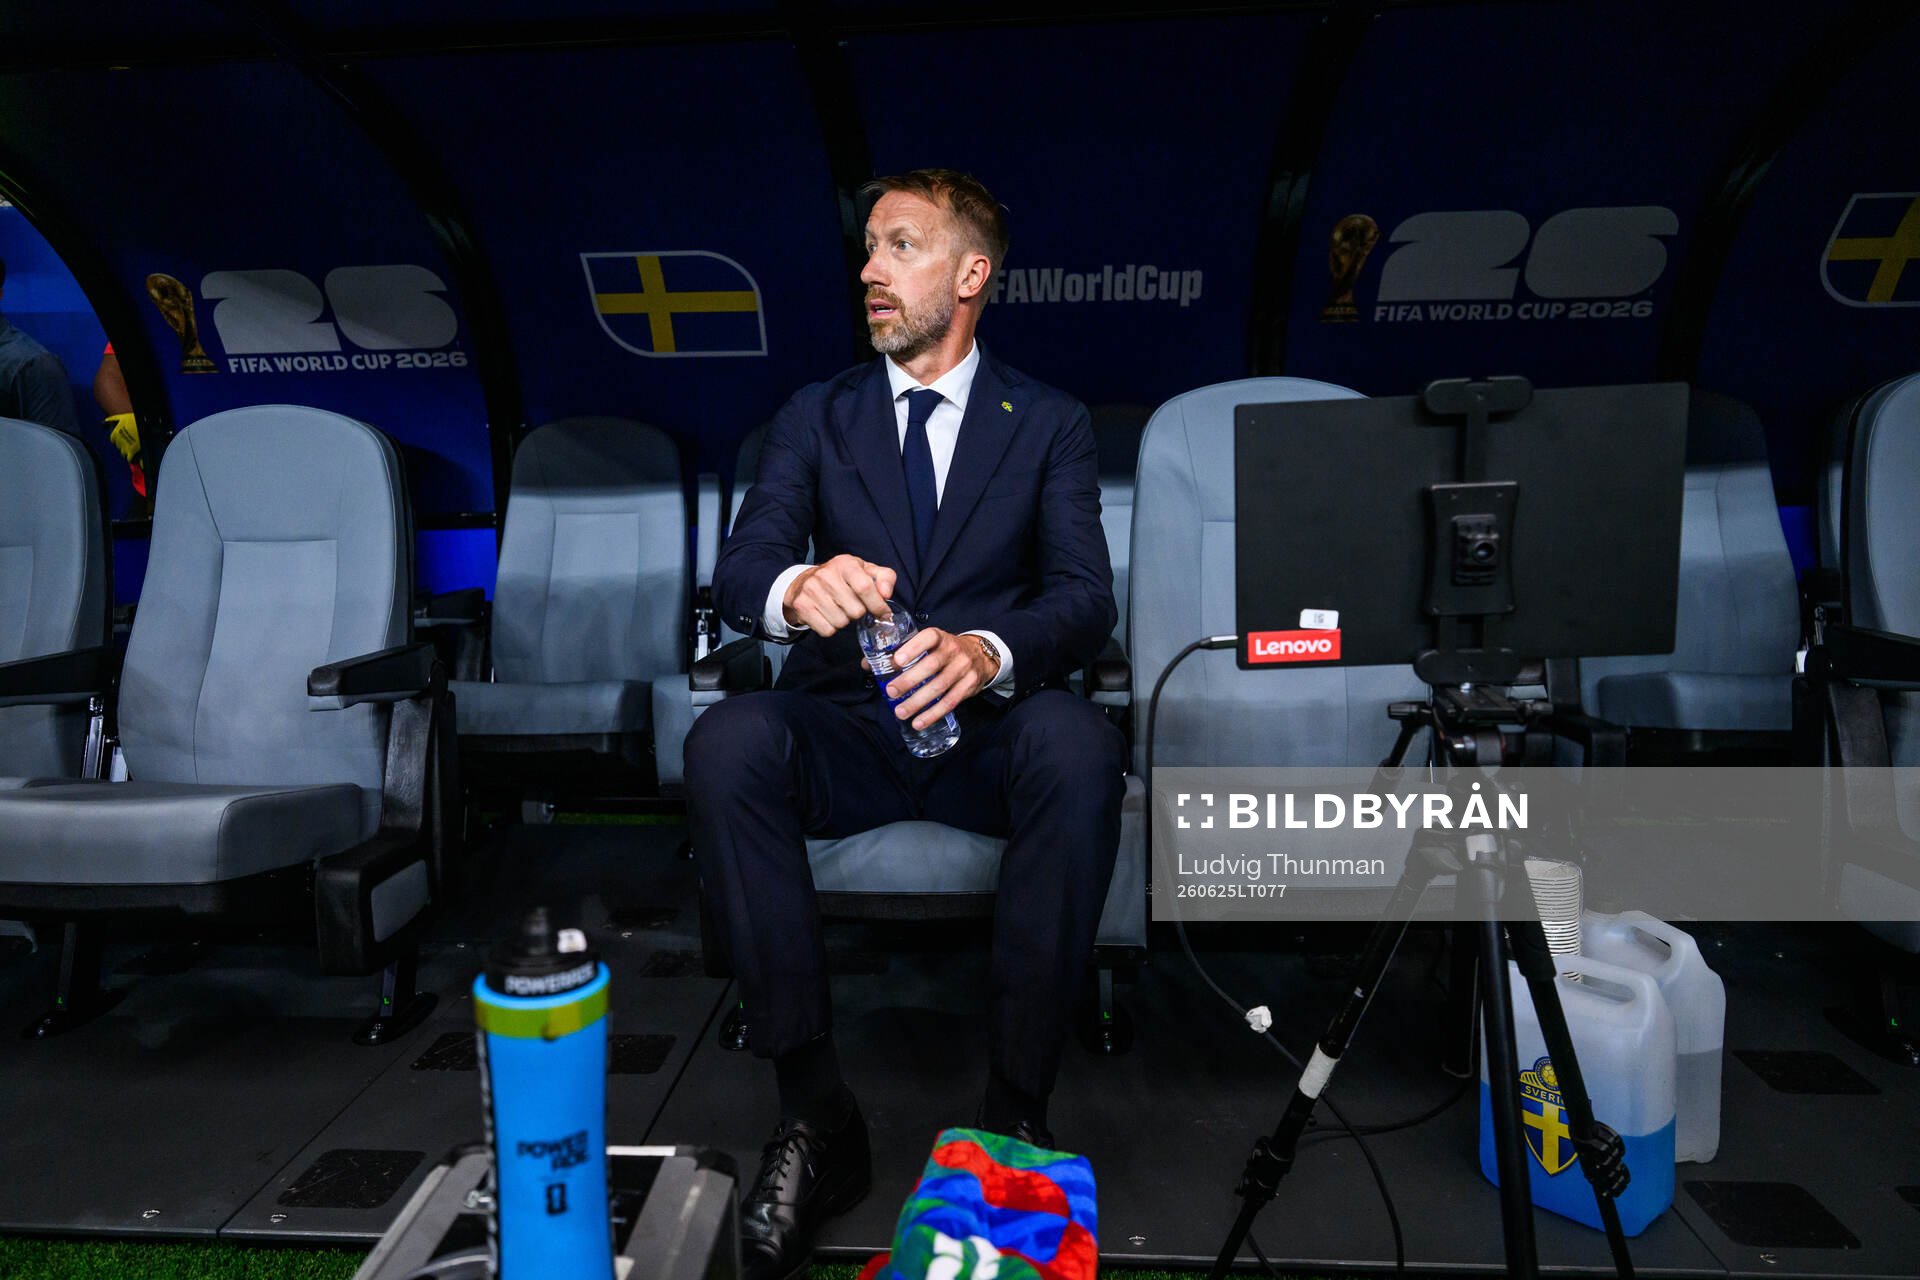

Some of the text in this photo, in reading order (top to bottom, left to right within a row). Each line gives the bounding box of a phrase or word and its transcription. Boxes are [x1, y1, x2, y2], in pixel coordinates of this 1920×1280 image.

[1373, 300, 1654, 322] FIFA WORLD CUP 2026
[227, 351, 469, 374] FIFA WORLD CUP 2026
[1255, 638, 1332, 656] Lenovo
[1525, 1084, 1564, 1105] SVERI
